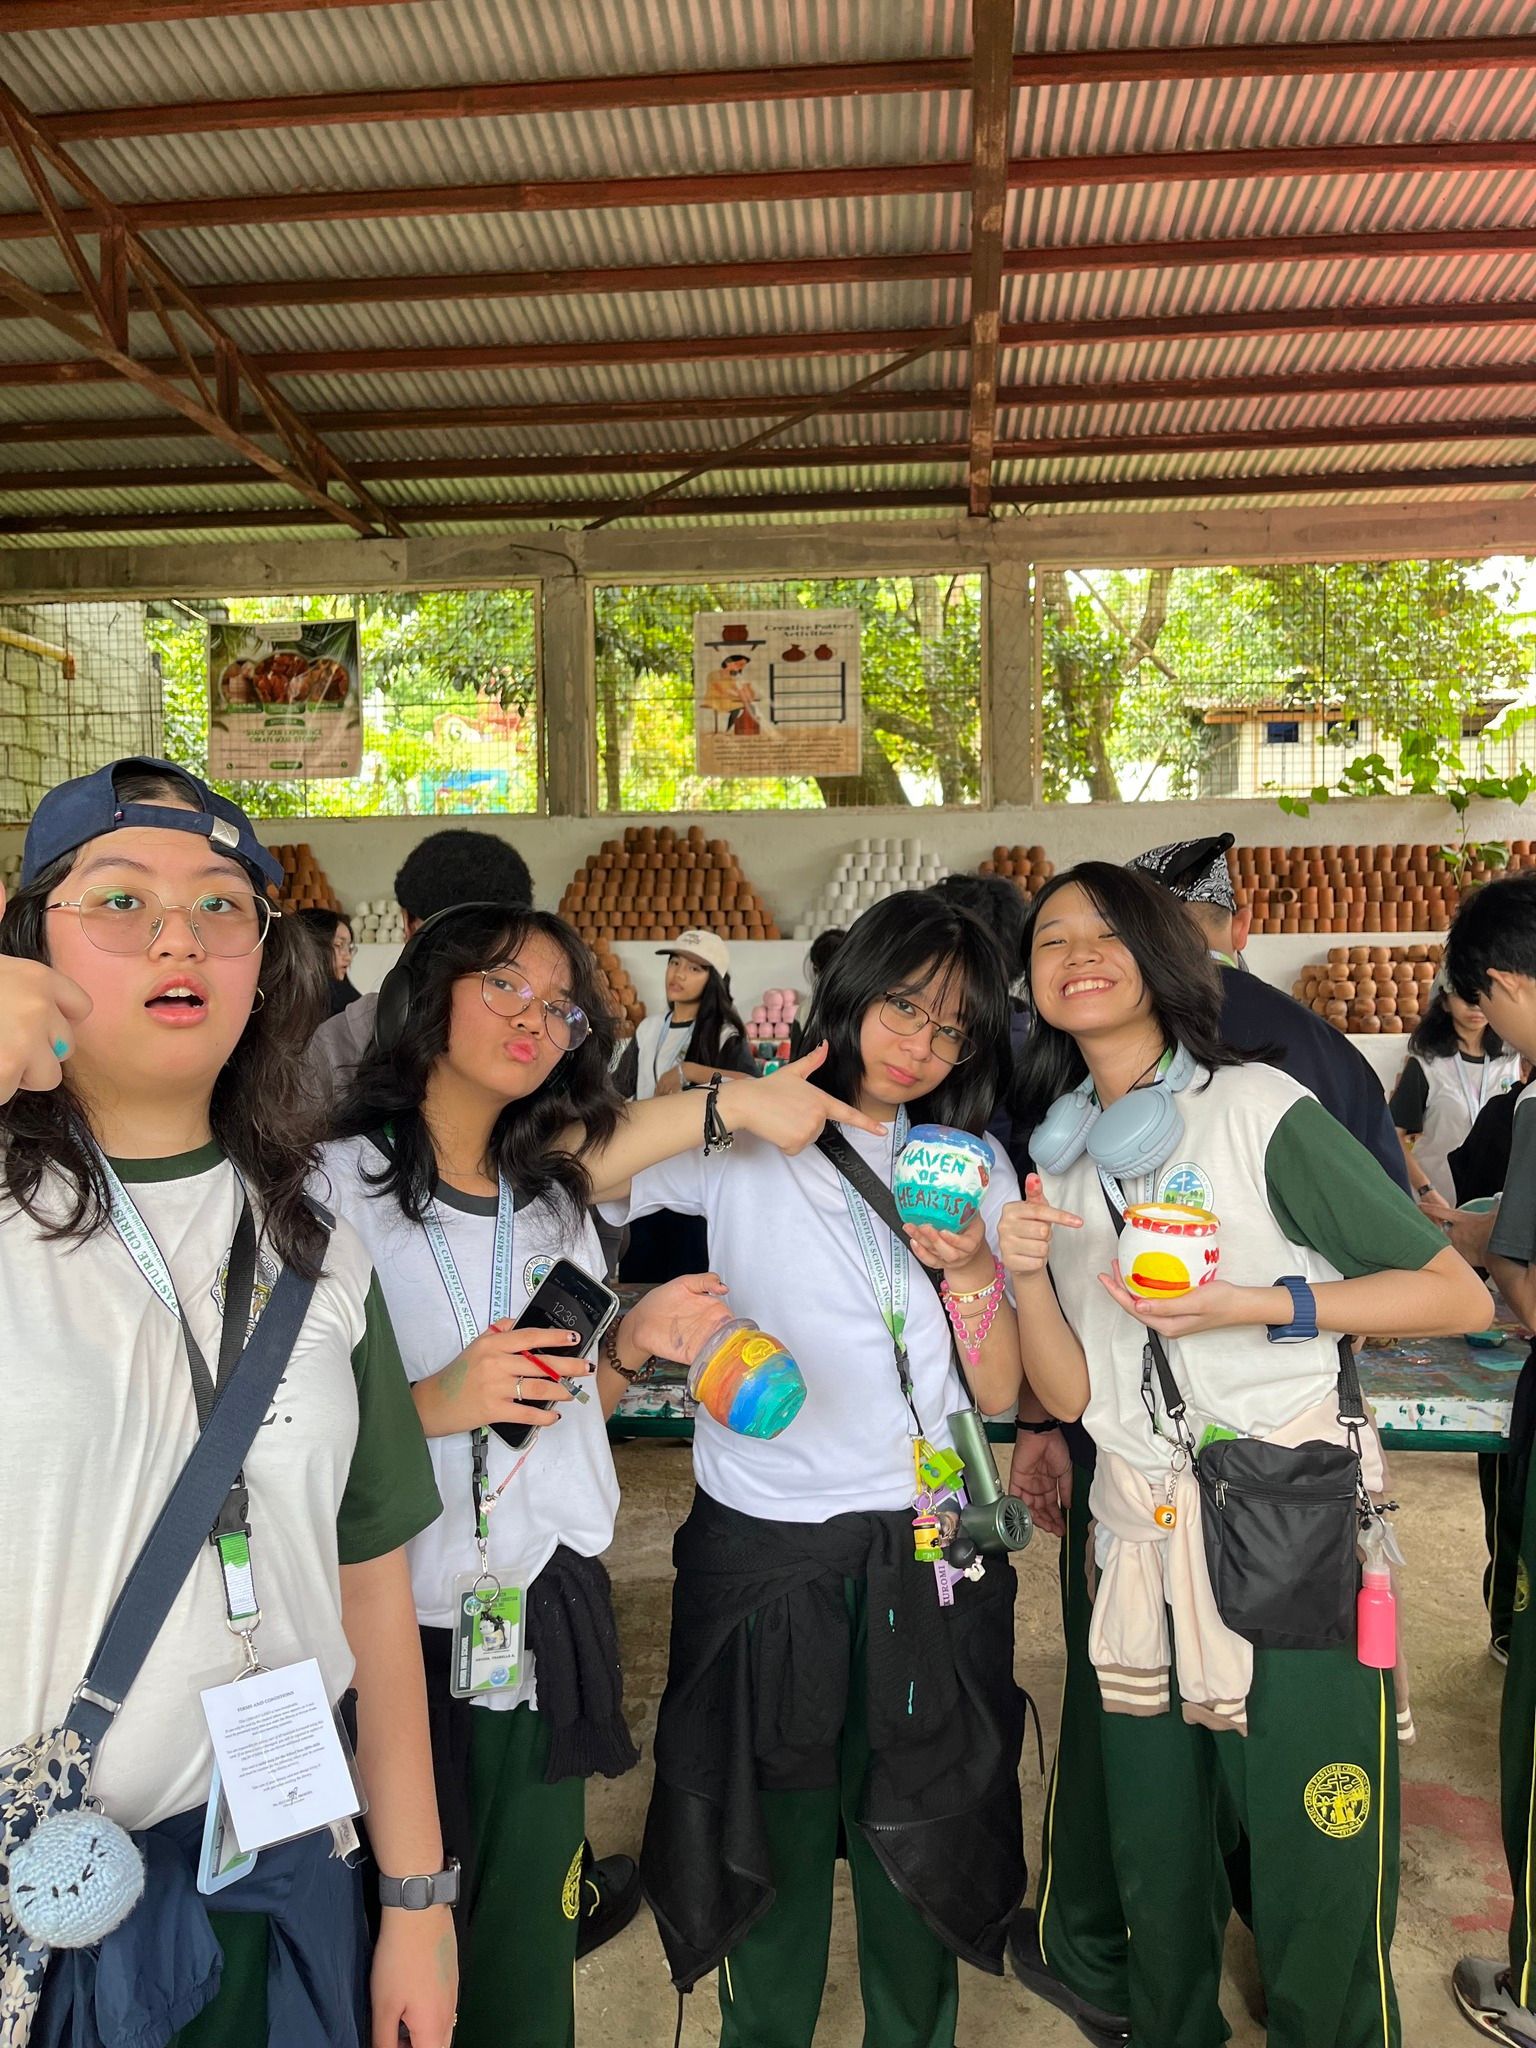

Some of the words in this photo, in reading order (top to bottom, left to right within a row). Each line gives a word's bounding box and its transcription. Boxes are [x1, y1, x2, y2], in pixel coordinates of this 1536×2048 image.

[764, 623, 811, 631] Creative
[815, 623, 854, 631] Pottery
[902, 1147, 966, 1176] HAVEN
[916, 1169, 939, 1183] OF
[897, 1186, 964, 1216] HEARTS
[495, 1213, 506, 1263] CHRISTIAN
[854, 1199, 875, 1247] CHRISTIAN
[869, 1247, 886, 1285] SCHOOL
[893, 1246, 901, 1275] GREEN
[136, 1249, 180, 1309] PASTURE
[440, 1247, 466, 1305] CHRISTIAN
[493, 1264, 502, 1307] PASTURE
[552, 1301, 578, 1327] 12:36
[252, 1699, 264, 1707] AND
[263, 1690, 295, 1704] CONDITIONS
[1313, 1765, 1342, 1785] PASTURE
